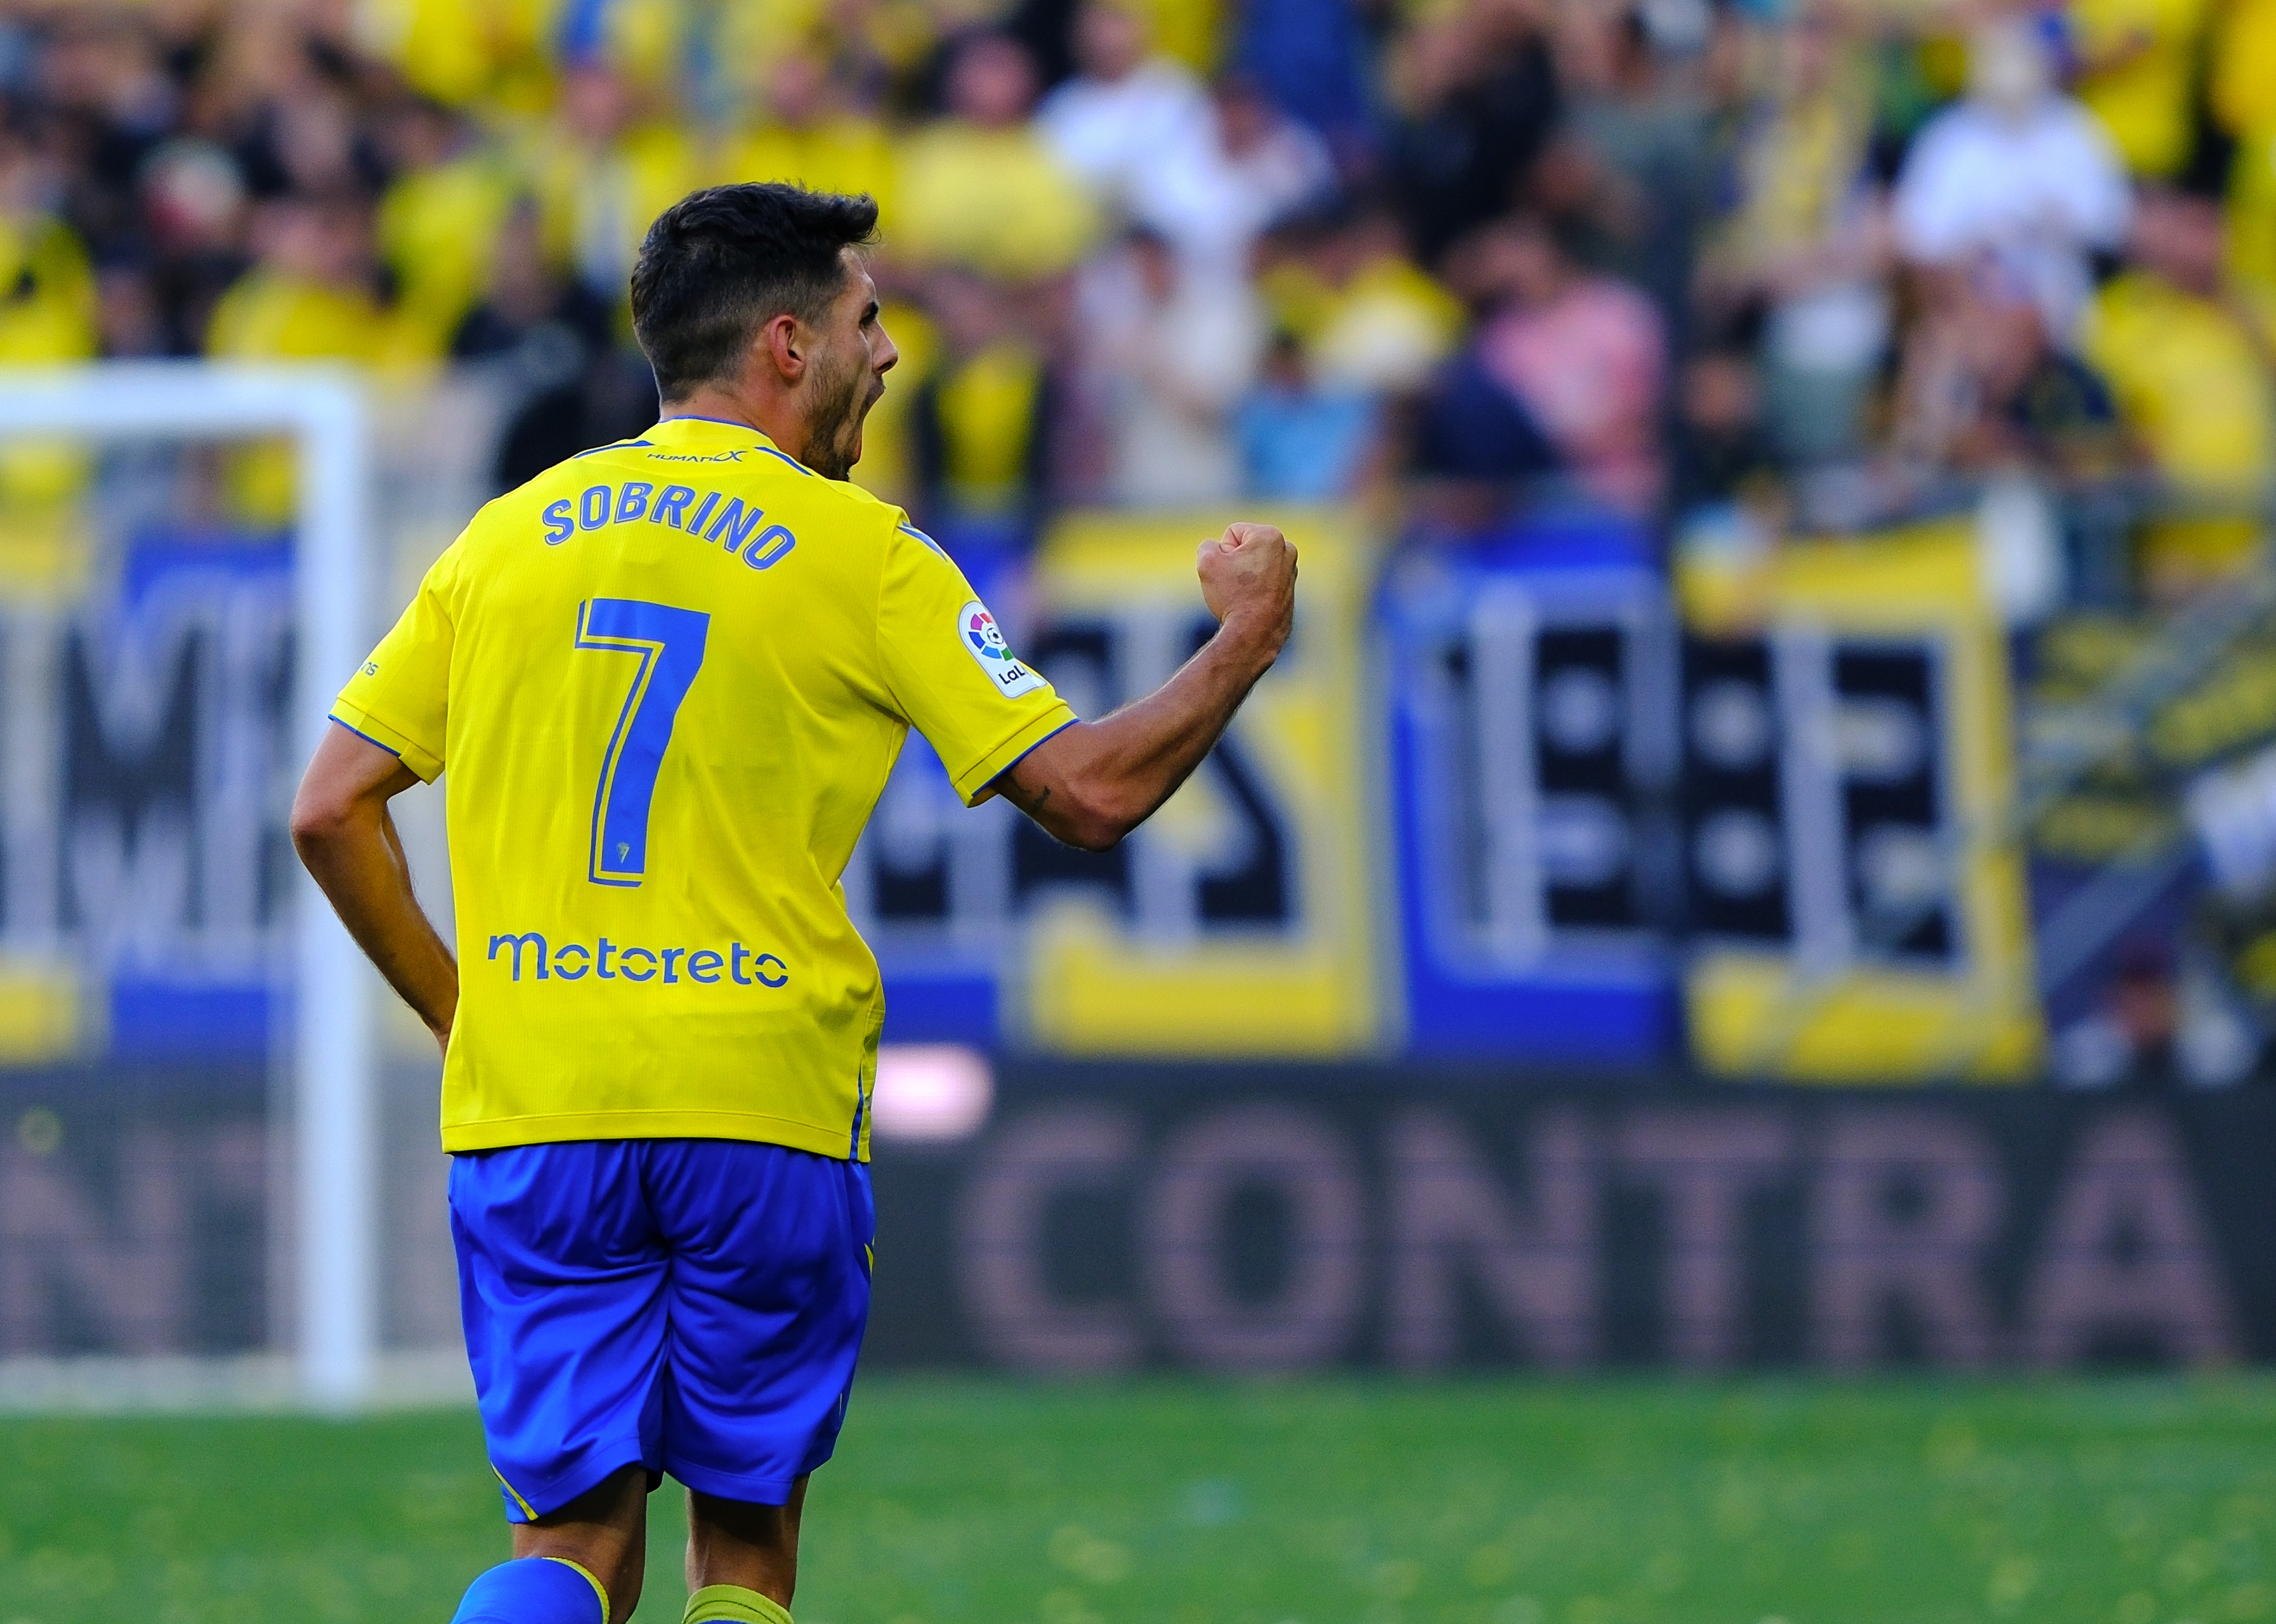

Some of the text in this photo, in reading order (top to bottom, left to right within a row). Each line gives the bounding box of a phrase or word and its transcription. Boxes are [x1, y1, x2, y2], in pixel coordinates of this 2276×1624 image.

[542, 481, 795, 571] SOBRINO
[575, 598, 711, 887] 7
[998, 665, 1026, 685] LaL
[964, 1104, 2246, 1372] CONTRA
